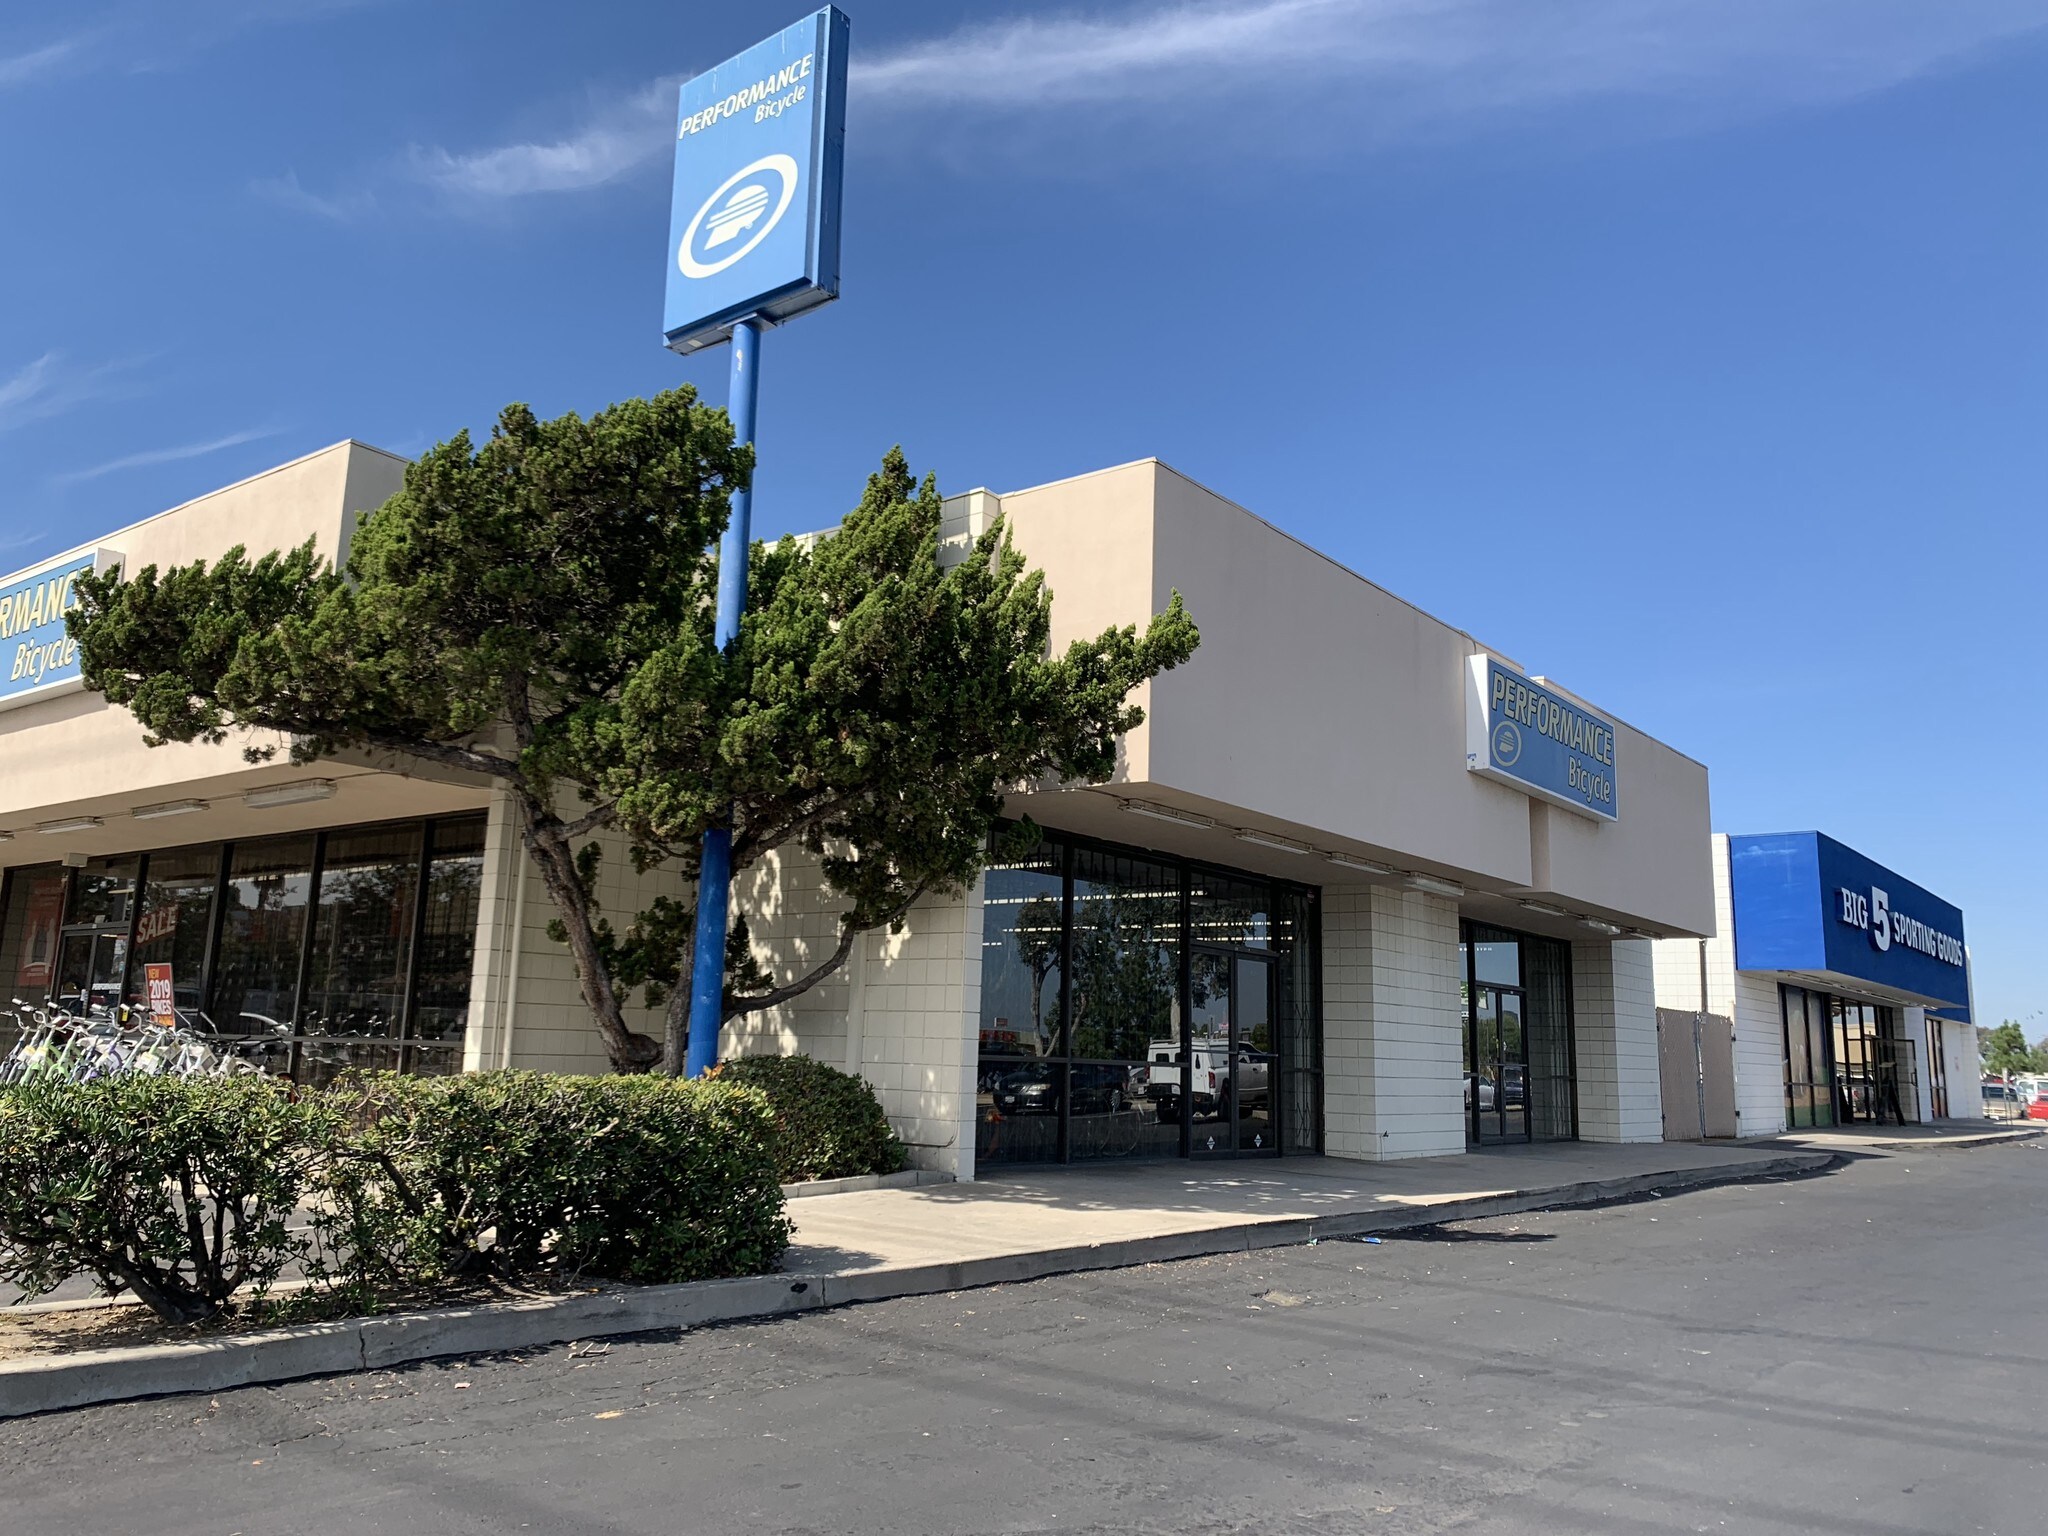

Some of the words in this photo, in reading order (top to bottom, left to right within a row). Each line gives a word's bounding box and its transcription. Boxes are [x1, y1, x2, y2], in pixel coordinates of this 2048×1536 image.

[678, 52, 813, 140] PERFORMANCE
[754, 84, 807, 124] Bicycle
[10, 632, 78, 685] Bicycle
[1492, 670, 1613, 766] PERFORMANCE
[1568, 755, 1611, 804] Bicycle
[136, 904, 179, 943] SALE
[1841, 887, 1869, 930] BIG
[1871, 885, 1891, 952] 5
[1893, 911, 1937, 957] SPORTING
[1937, 932, 1963, 967] GOODS
[149, 979, 171, 999] 2019
